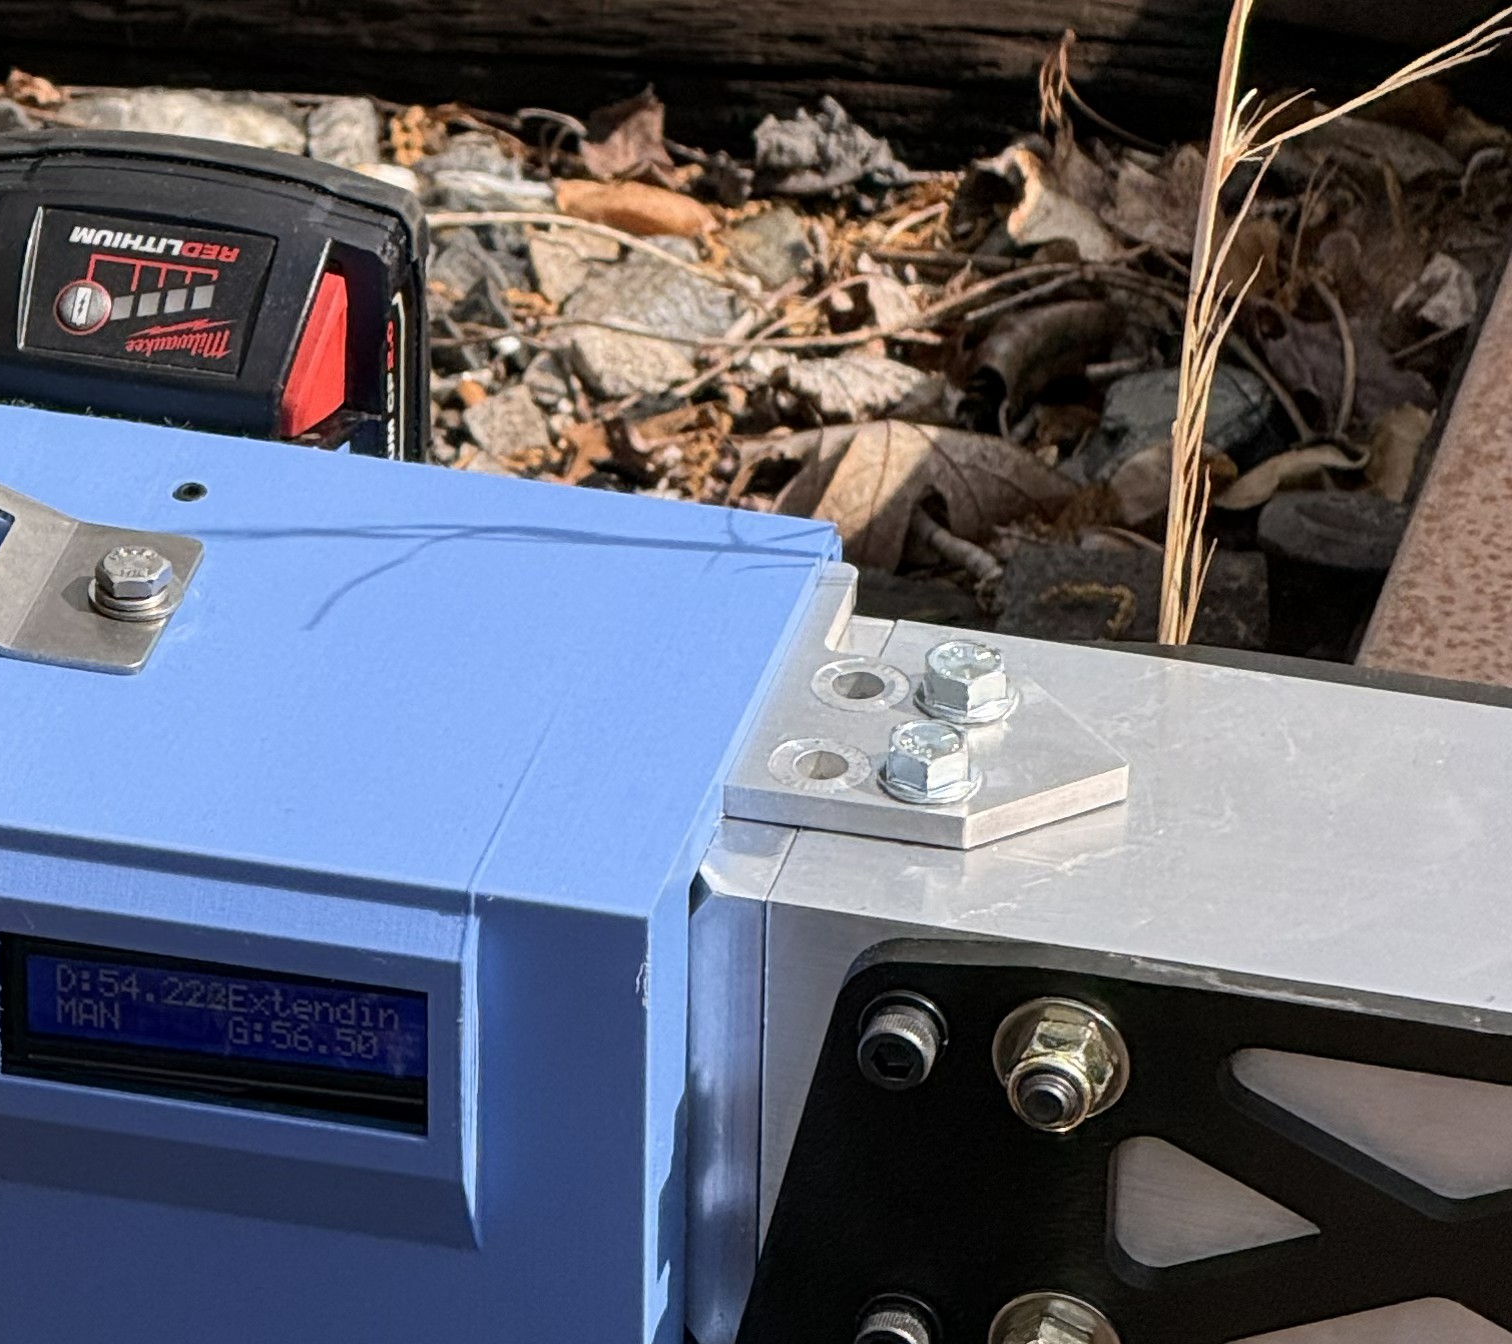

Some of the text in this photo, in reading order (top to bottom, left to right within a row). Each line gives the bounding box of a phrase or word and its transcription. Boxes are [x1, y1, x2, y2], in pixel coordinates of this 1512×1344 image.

[69, 225, 241, 263] REDLITHIUM
[125, 329, 232, 360] Milwaukee
[56, 995, 378, 1060] MAN G:56.50
